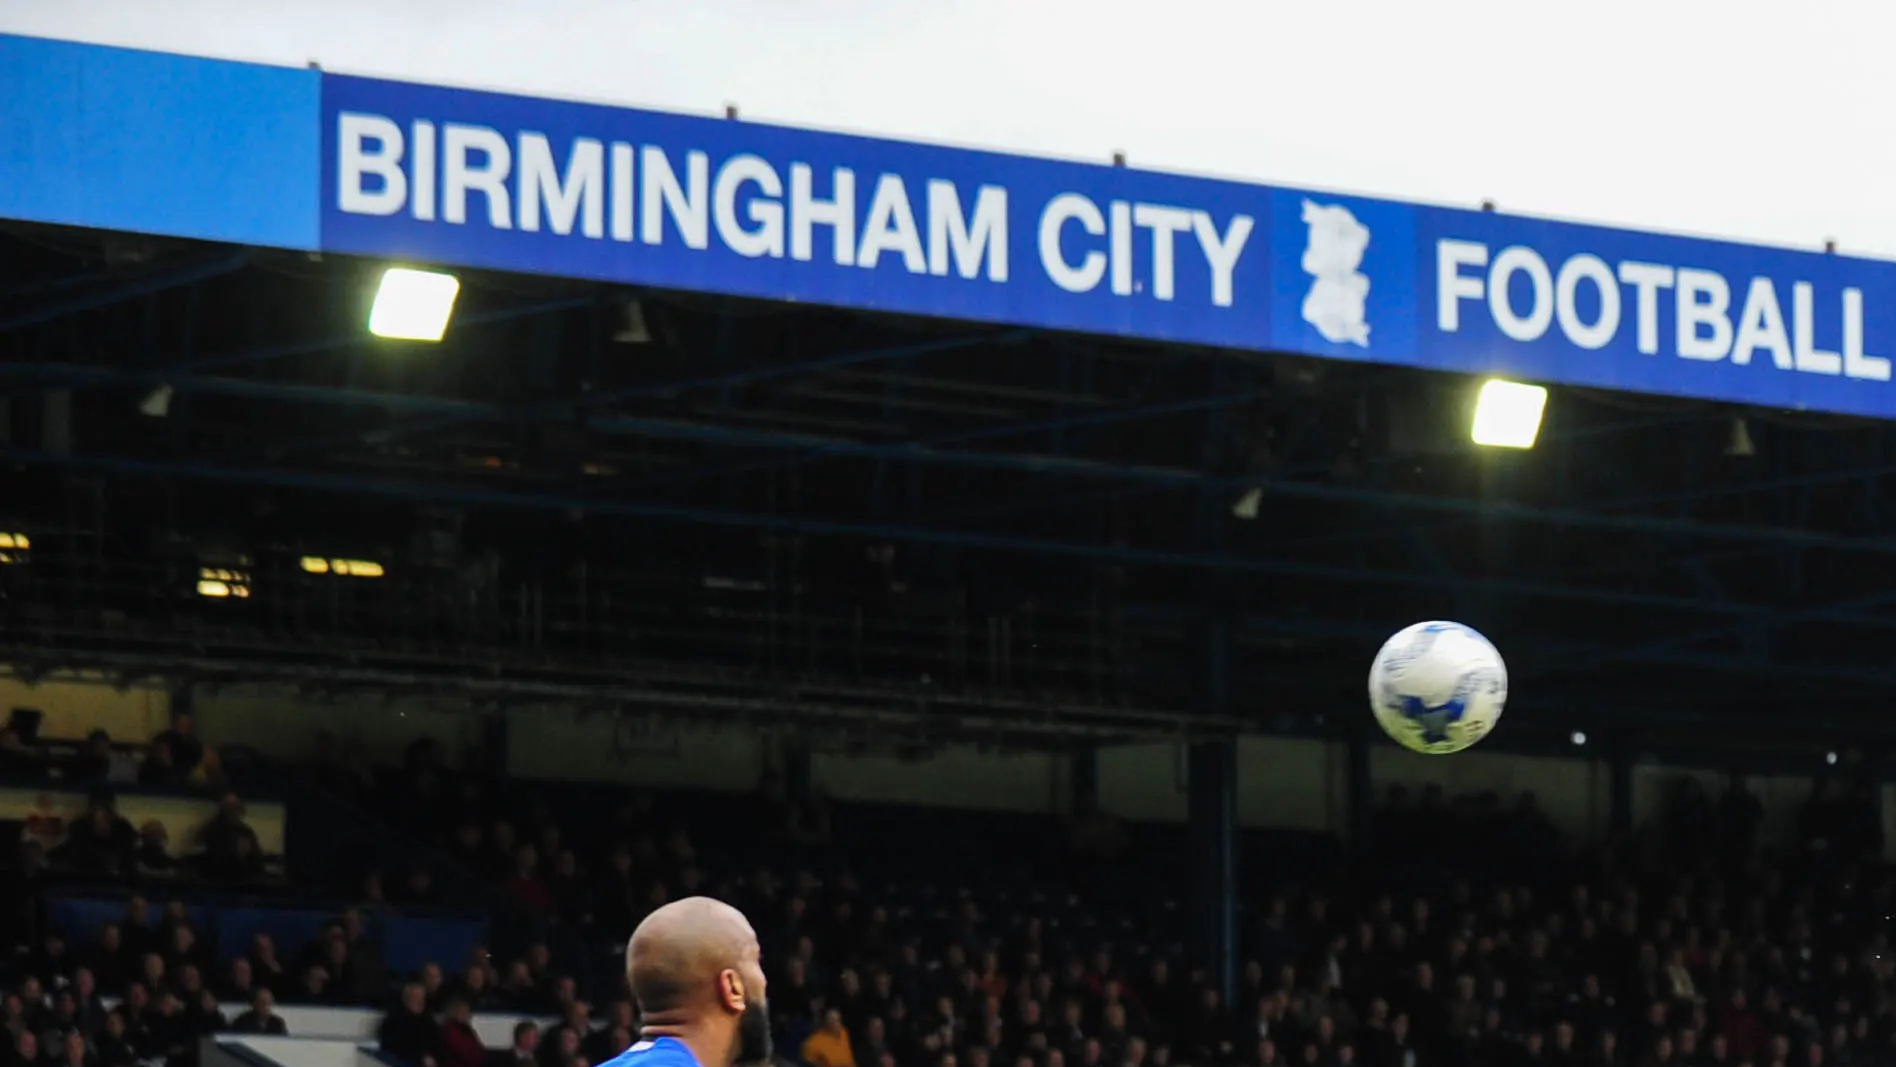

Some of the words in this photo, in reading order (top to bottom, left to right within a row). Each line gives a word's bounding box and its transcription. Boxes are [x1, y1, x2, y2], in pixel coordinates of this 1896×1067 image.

[336, 111, 1008, 282] BIRMINGHAM
[1037, 192, 1254, 306] CITY
[1436, 239, 1892, 382] FOOTBALL
